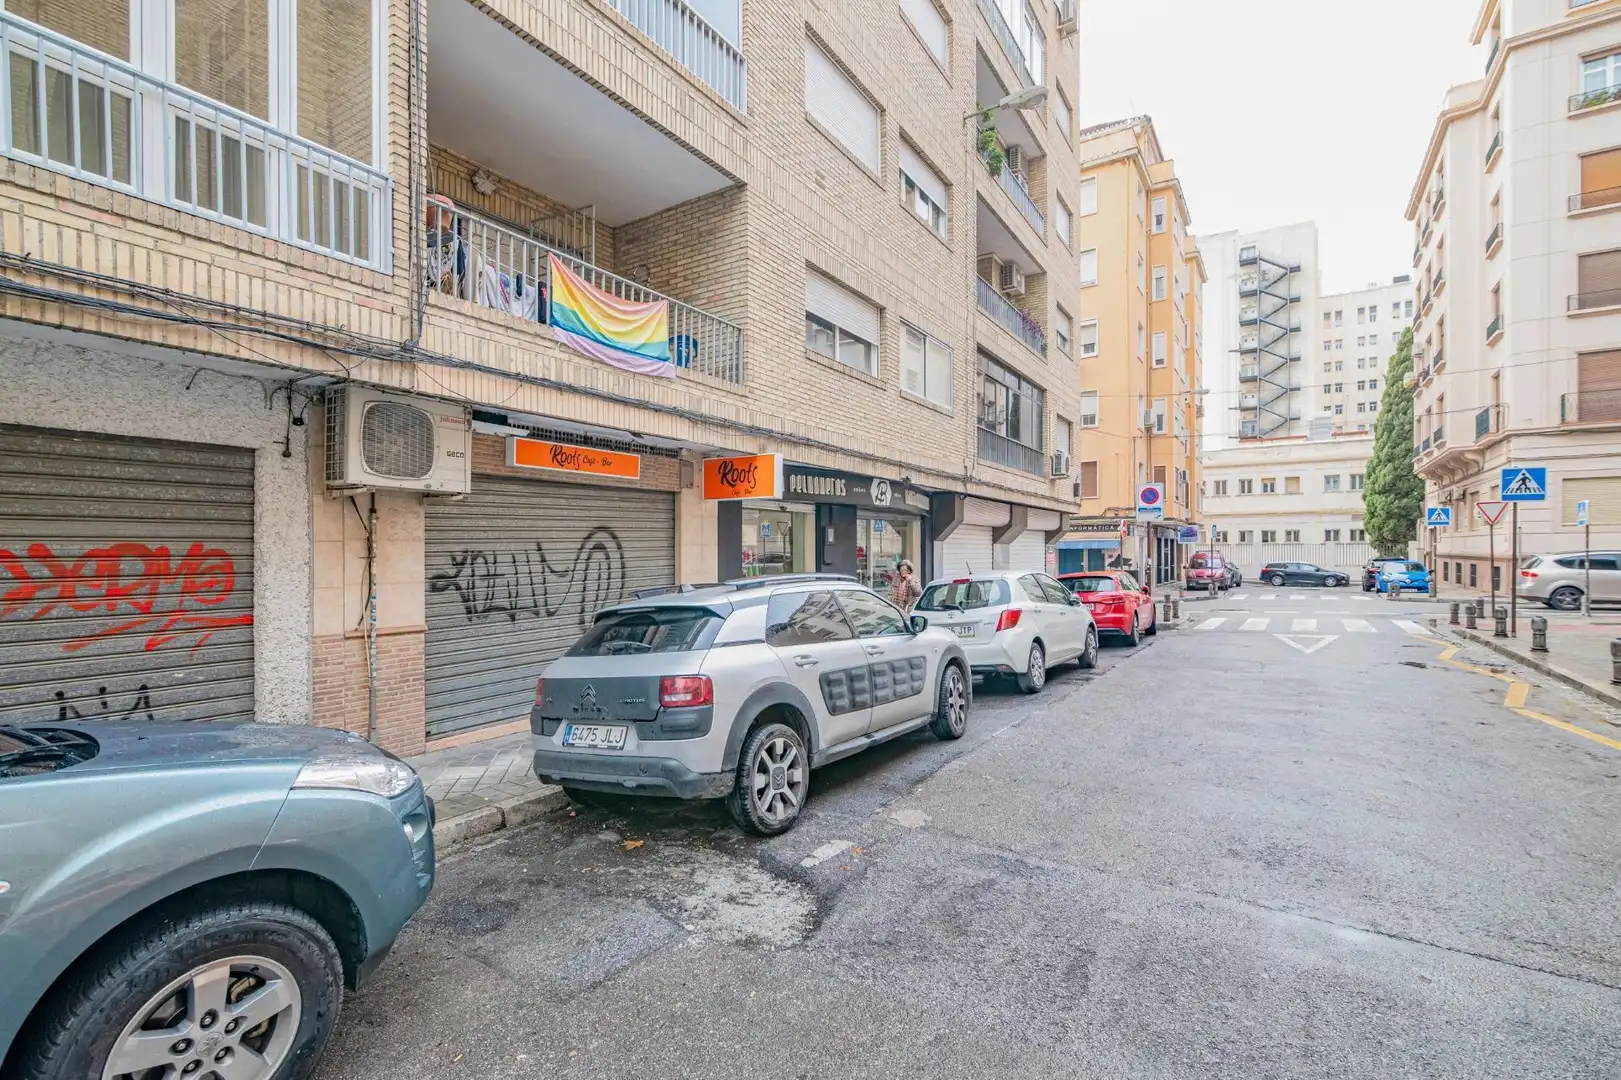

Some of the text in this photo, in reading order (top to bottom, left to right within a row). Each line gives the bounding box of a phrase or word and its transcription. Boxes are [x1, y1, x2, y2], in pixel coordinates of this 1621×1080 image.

[550, 445, 581, 470] Roots
[718, 461, 757, 489] Roots
[958, 626, 972, 635] JTP
[571, 727, 624, 744] 6475 JLJ
